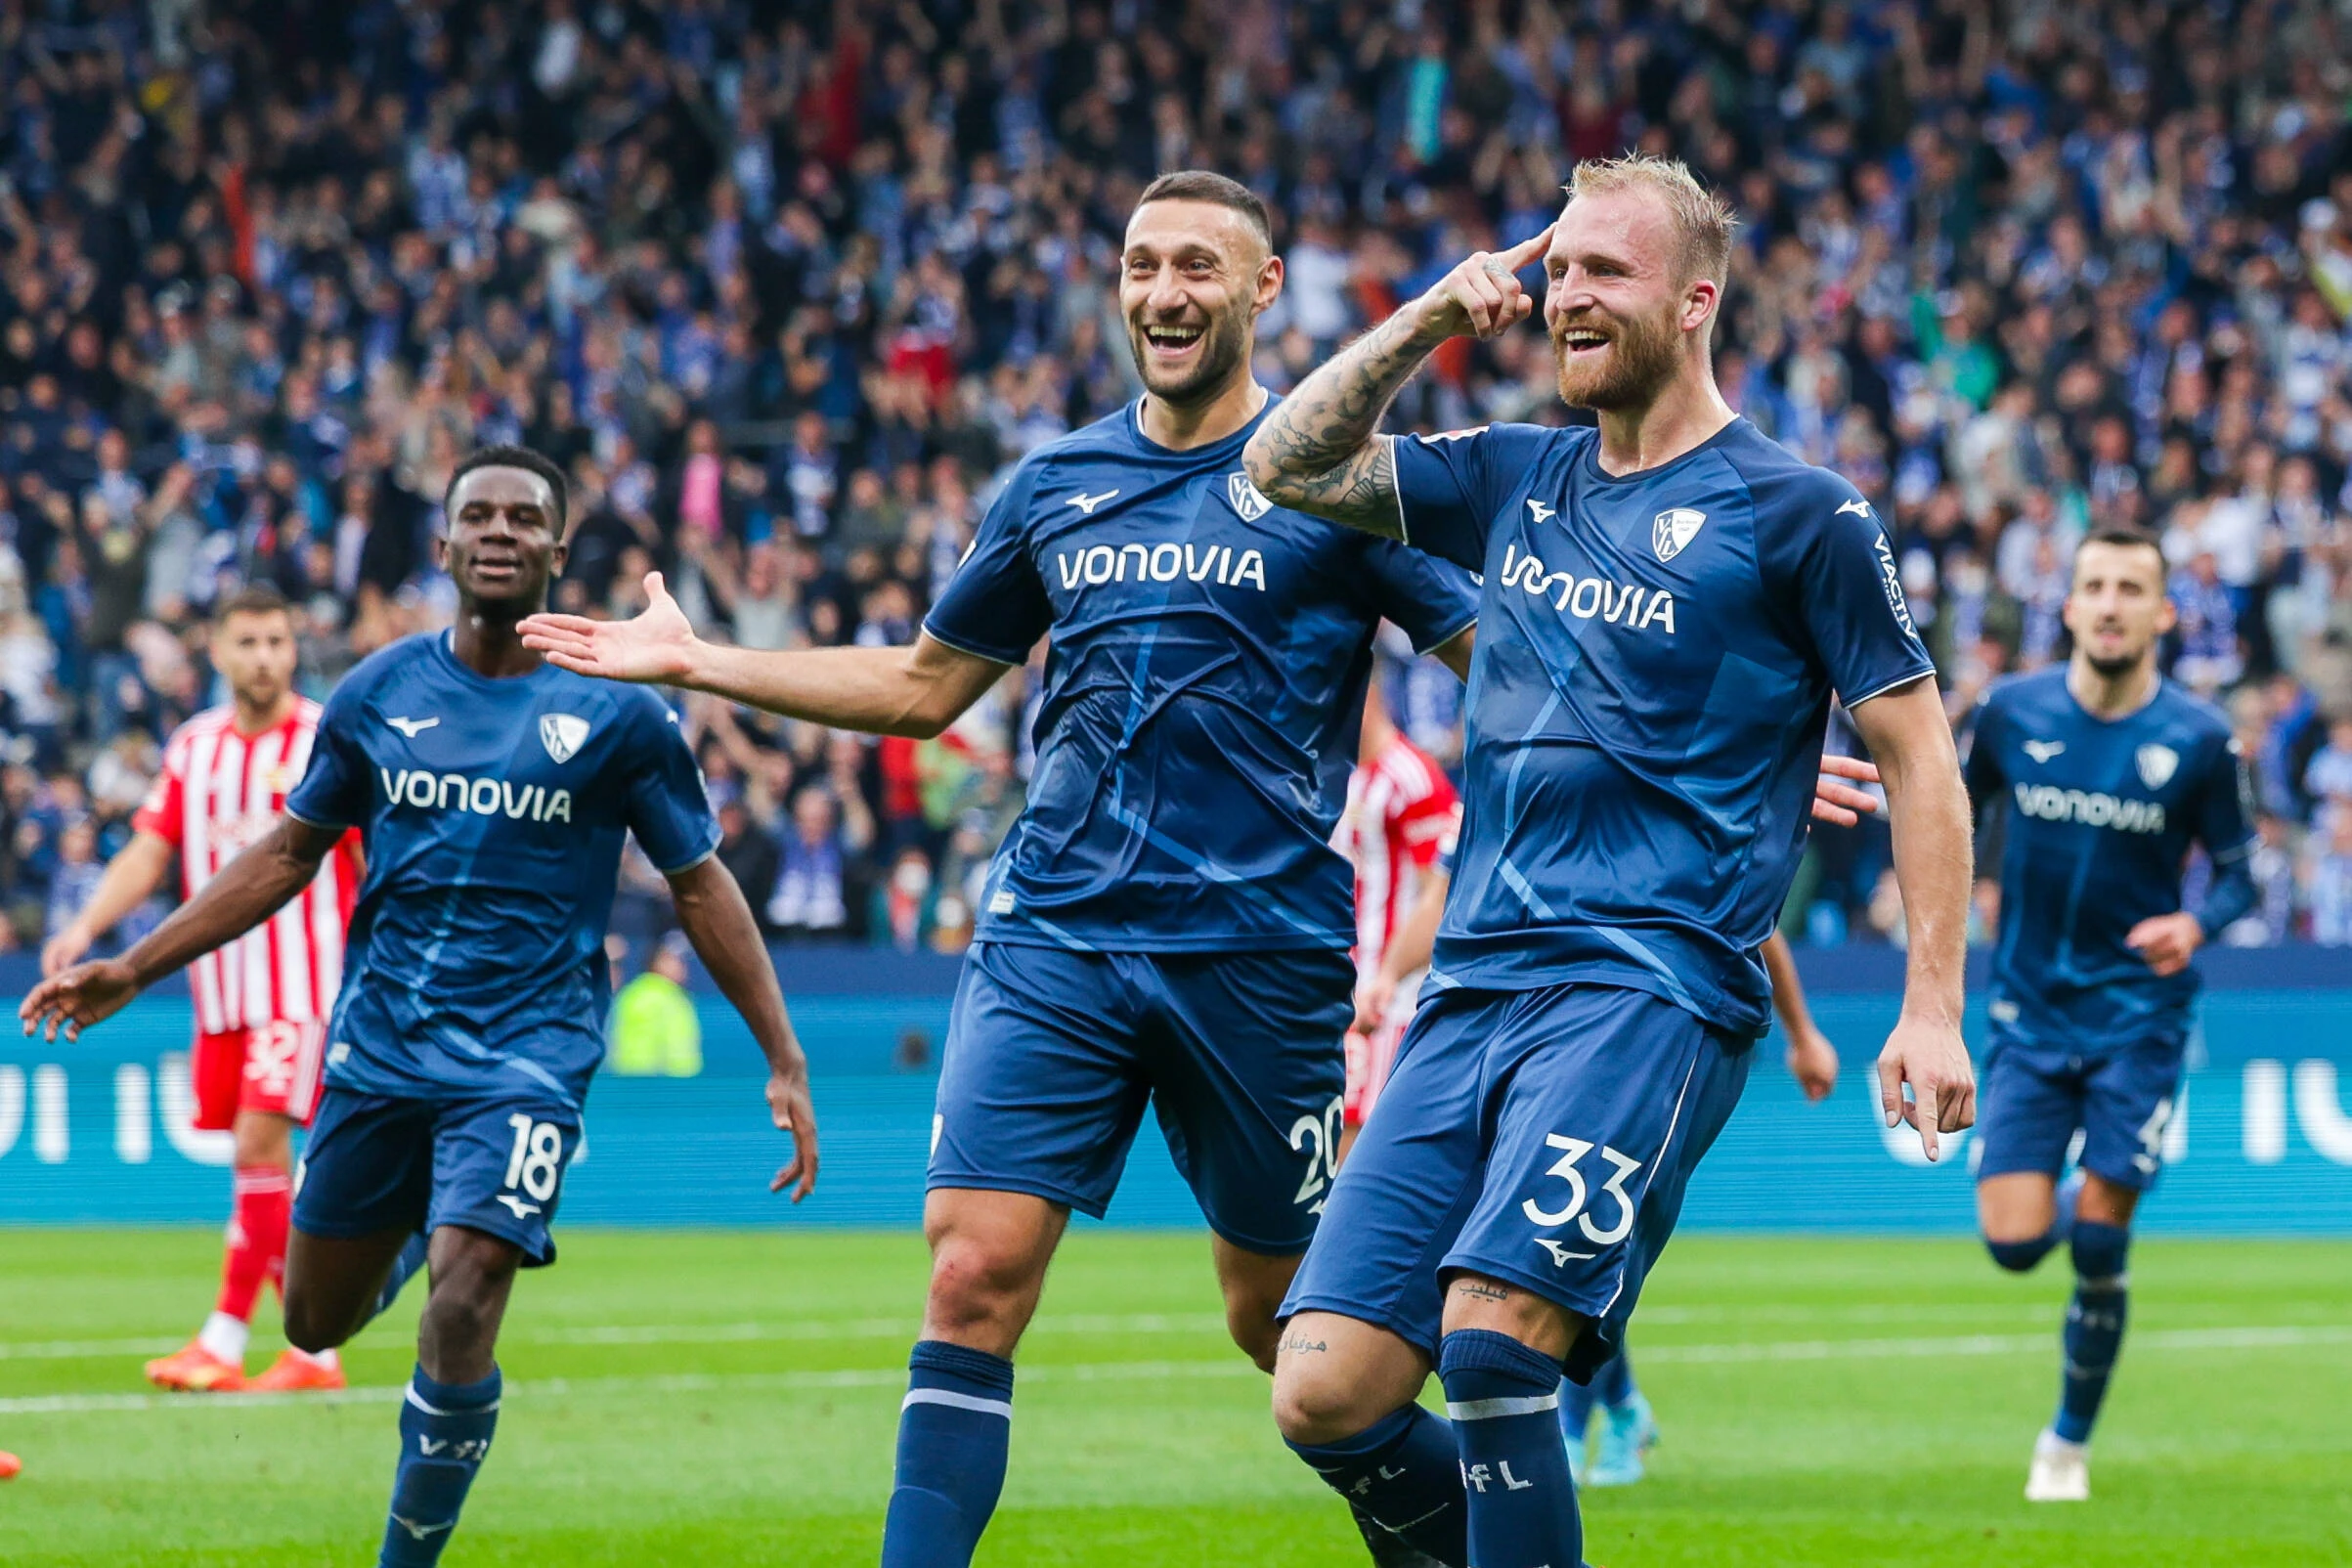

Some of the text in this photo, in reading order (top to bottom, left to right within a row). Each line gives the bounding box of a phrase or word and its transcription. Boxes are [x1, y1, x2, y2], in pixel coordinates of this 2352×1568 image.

[1058, 543, 1266, 591] VONOVIA
[1874, 532, 1918, 639] VIACTIV
[380, 766, 572, 823] VONOVIA
[503, 1112, 562, 1201] 18
[1289, 1095, 1345, 1204] 20
[1521, 1133, 1642, 1245] 33
